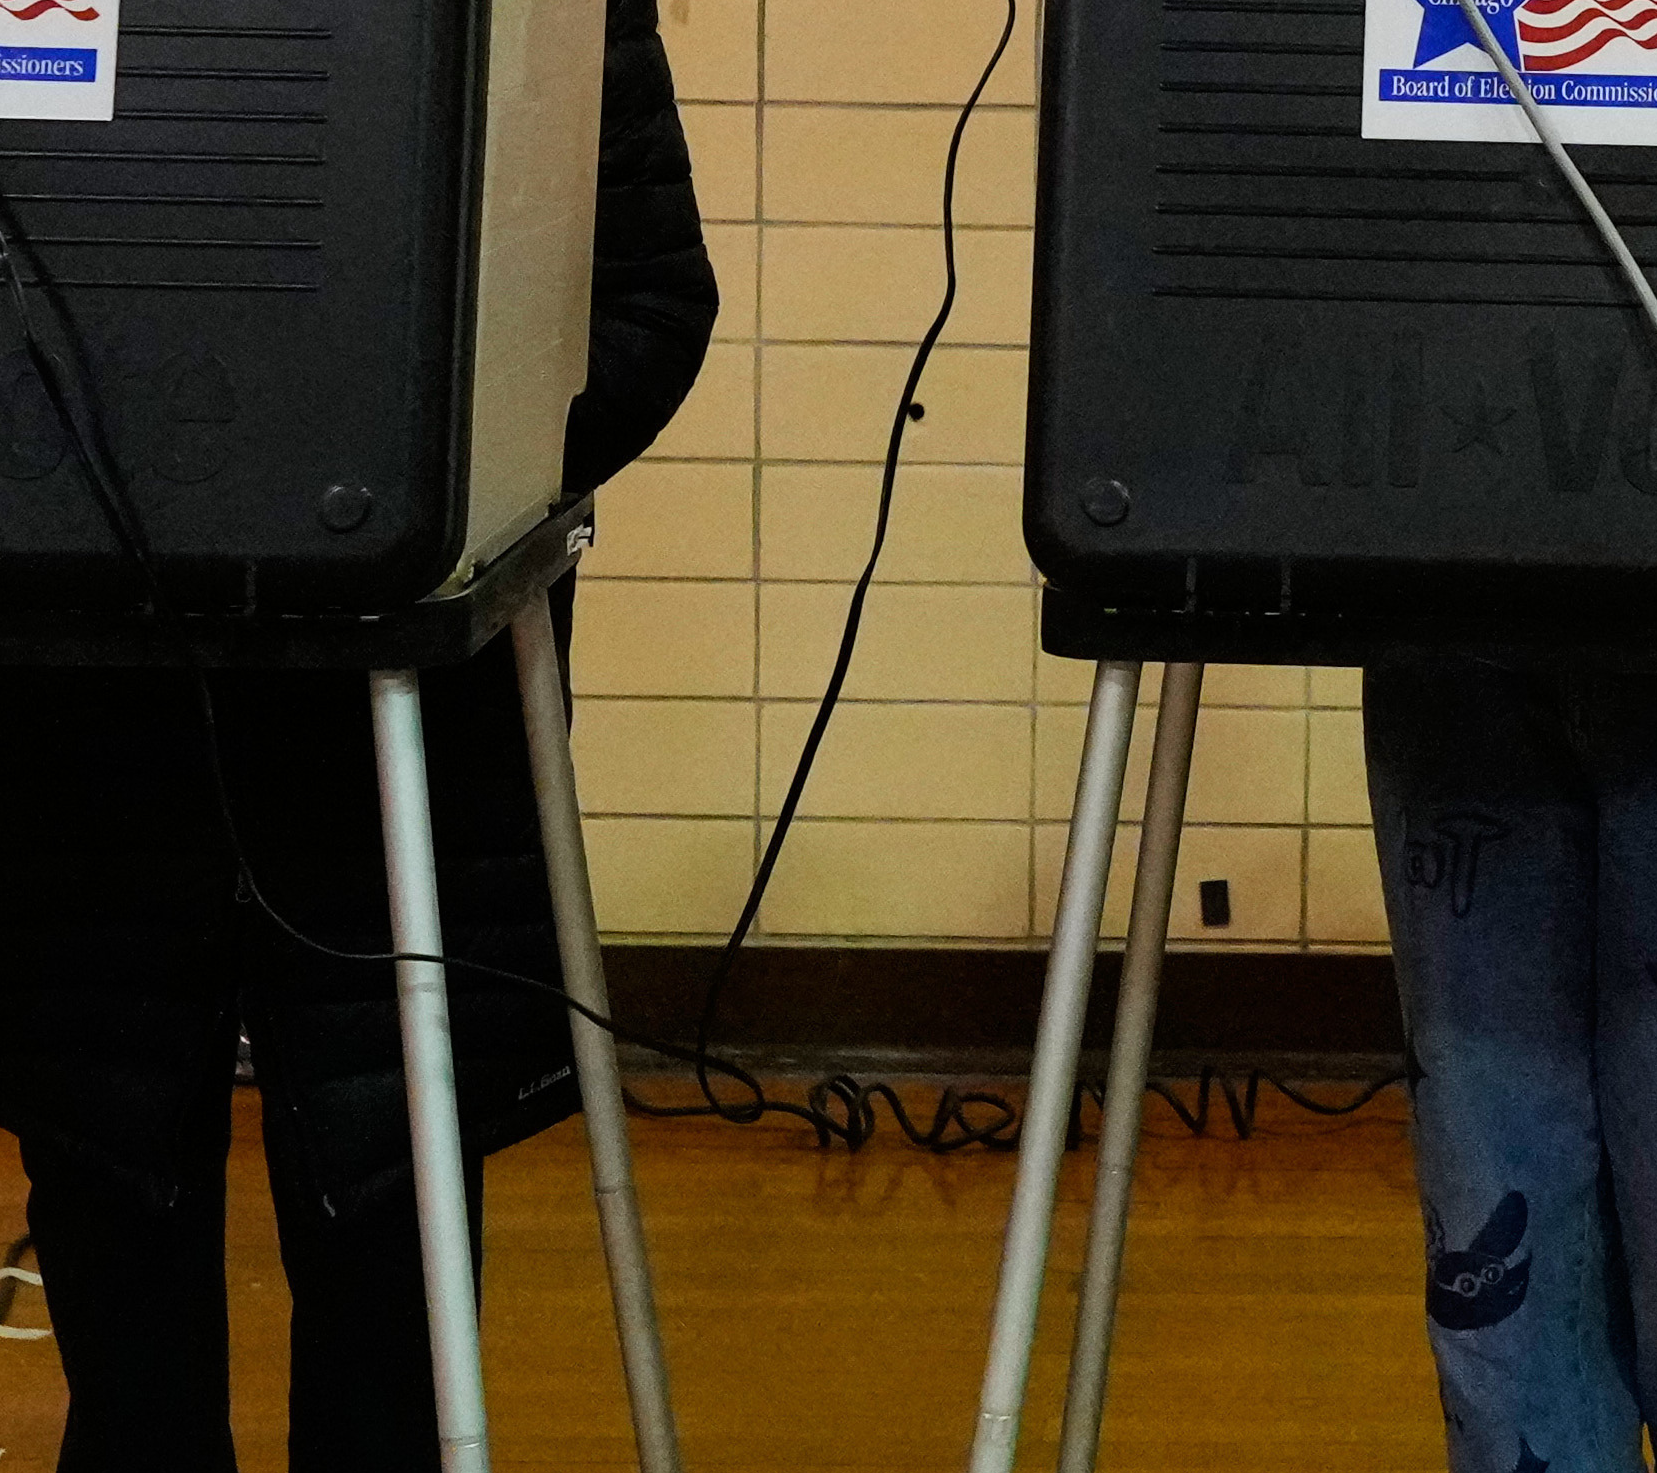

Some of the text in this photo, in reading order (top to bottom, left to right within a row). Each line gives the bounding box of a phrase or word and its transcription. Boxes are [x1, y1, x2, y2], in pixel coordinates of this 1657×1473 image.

[1391, 75, 1450, 98] Board
[1454, 76, 1476, 98] of
[1479, 76, 1557, 100] Eleion
